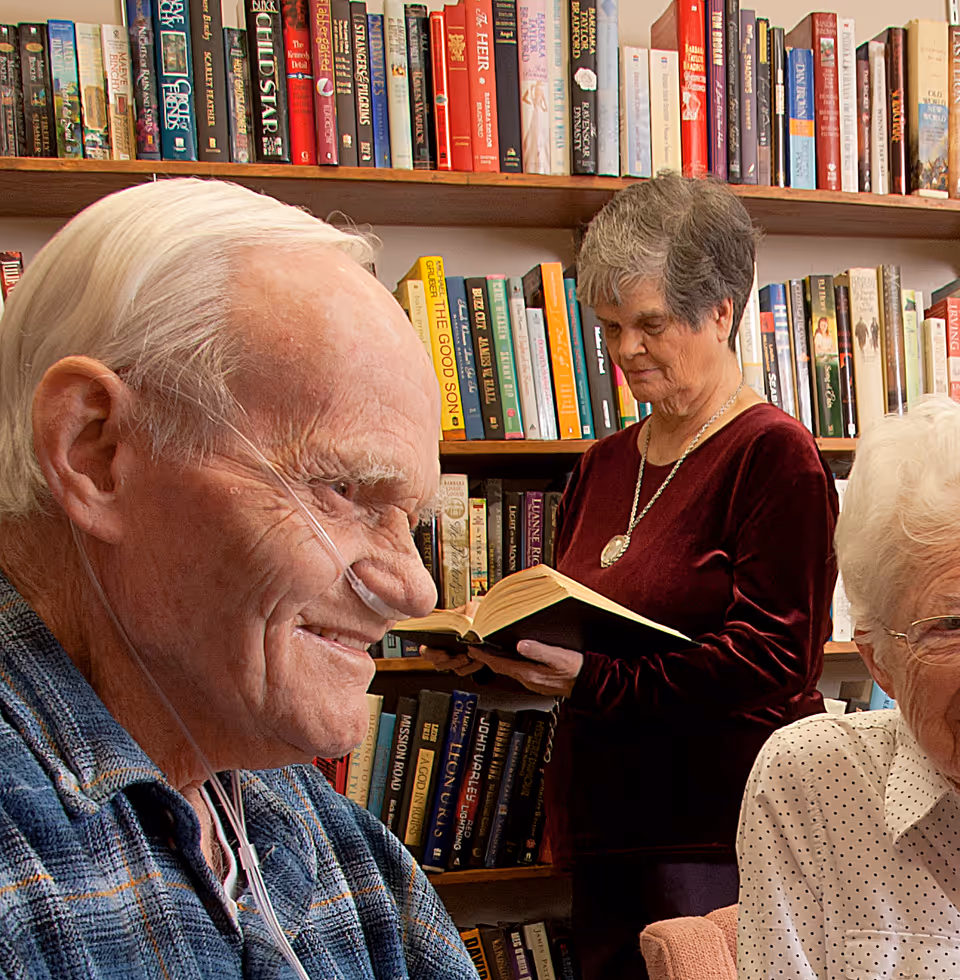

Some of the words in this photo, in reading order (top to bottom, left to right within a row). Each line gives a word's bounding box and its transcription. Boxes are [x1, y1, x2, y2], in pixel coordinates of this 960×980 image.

[138, 26, 148, 58] NIGHTS
[256, 12, 275, 76] CHILD
[571, 2, 580, 59] BRADFORD
[580, 10, 589, 50] TAYLOR
[354, 24, 366, 76] STRANGERS
[476, 32, 490, 72] HEIR
[110, 54, 120, 92] BINCHY
[120, 52, 128, 86] MAEVE
[204, 51, 212, 88] SCARLET
[233, 59, 244, 78] HOLY
[796, 64, 806, 82] DAN
[162, 82, 179, 130] FRIENDS
[175, 80, 192, 123] CIRCLE
[206, 90, 215, 126] FEATHER
[259, 80, 278, 134] STAR
[358, 82, 370, 125] PILGRIMS
[425, 260, 438, 298] GRUBER
[434, 260, 446, 298] MICHAEL
[434, 300, 448, 330] THE
[472, 288, 484, 310] BUZZ
[474, 310, 486, 330] CUT
[775, 304, 790, 344] HILL
[950, 304, 960, 350] IRVING
[438, 334, 454, 378] GOOD
[478, 336, 490, 366] JAMES
[445, 382, 460, 414] SON
[484, 379, 496, 404] HALL
[508, 505, 516, 530] LIGHT
[531, 498, 542, 543] LUANNE
[509, 544, 517, 570] MOON
[531, 546, 542, 568] RIC
[396, 714, 412, 760] MISSION
[476, 718, 490, 752] JOHN
[390, 760, 405, 791] ROAD
[417, 766, 428, 788] GOD
[444, 742, 463, 787] LEON
[466, 754, 484, 803] VARLEY
[415, 790, 424, 804] IN
[434, 792, 452, 838] URIS
[408, 804, 422, 836] RUINS
[453, 804, 470, 851] LIGHTNING
[464, 820, 474, 838] RED
[511, 932, 522, 948] MEG
[534, 928, 544, 954] JAMES
